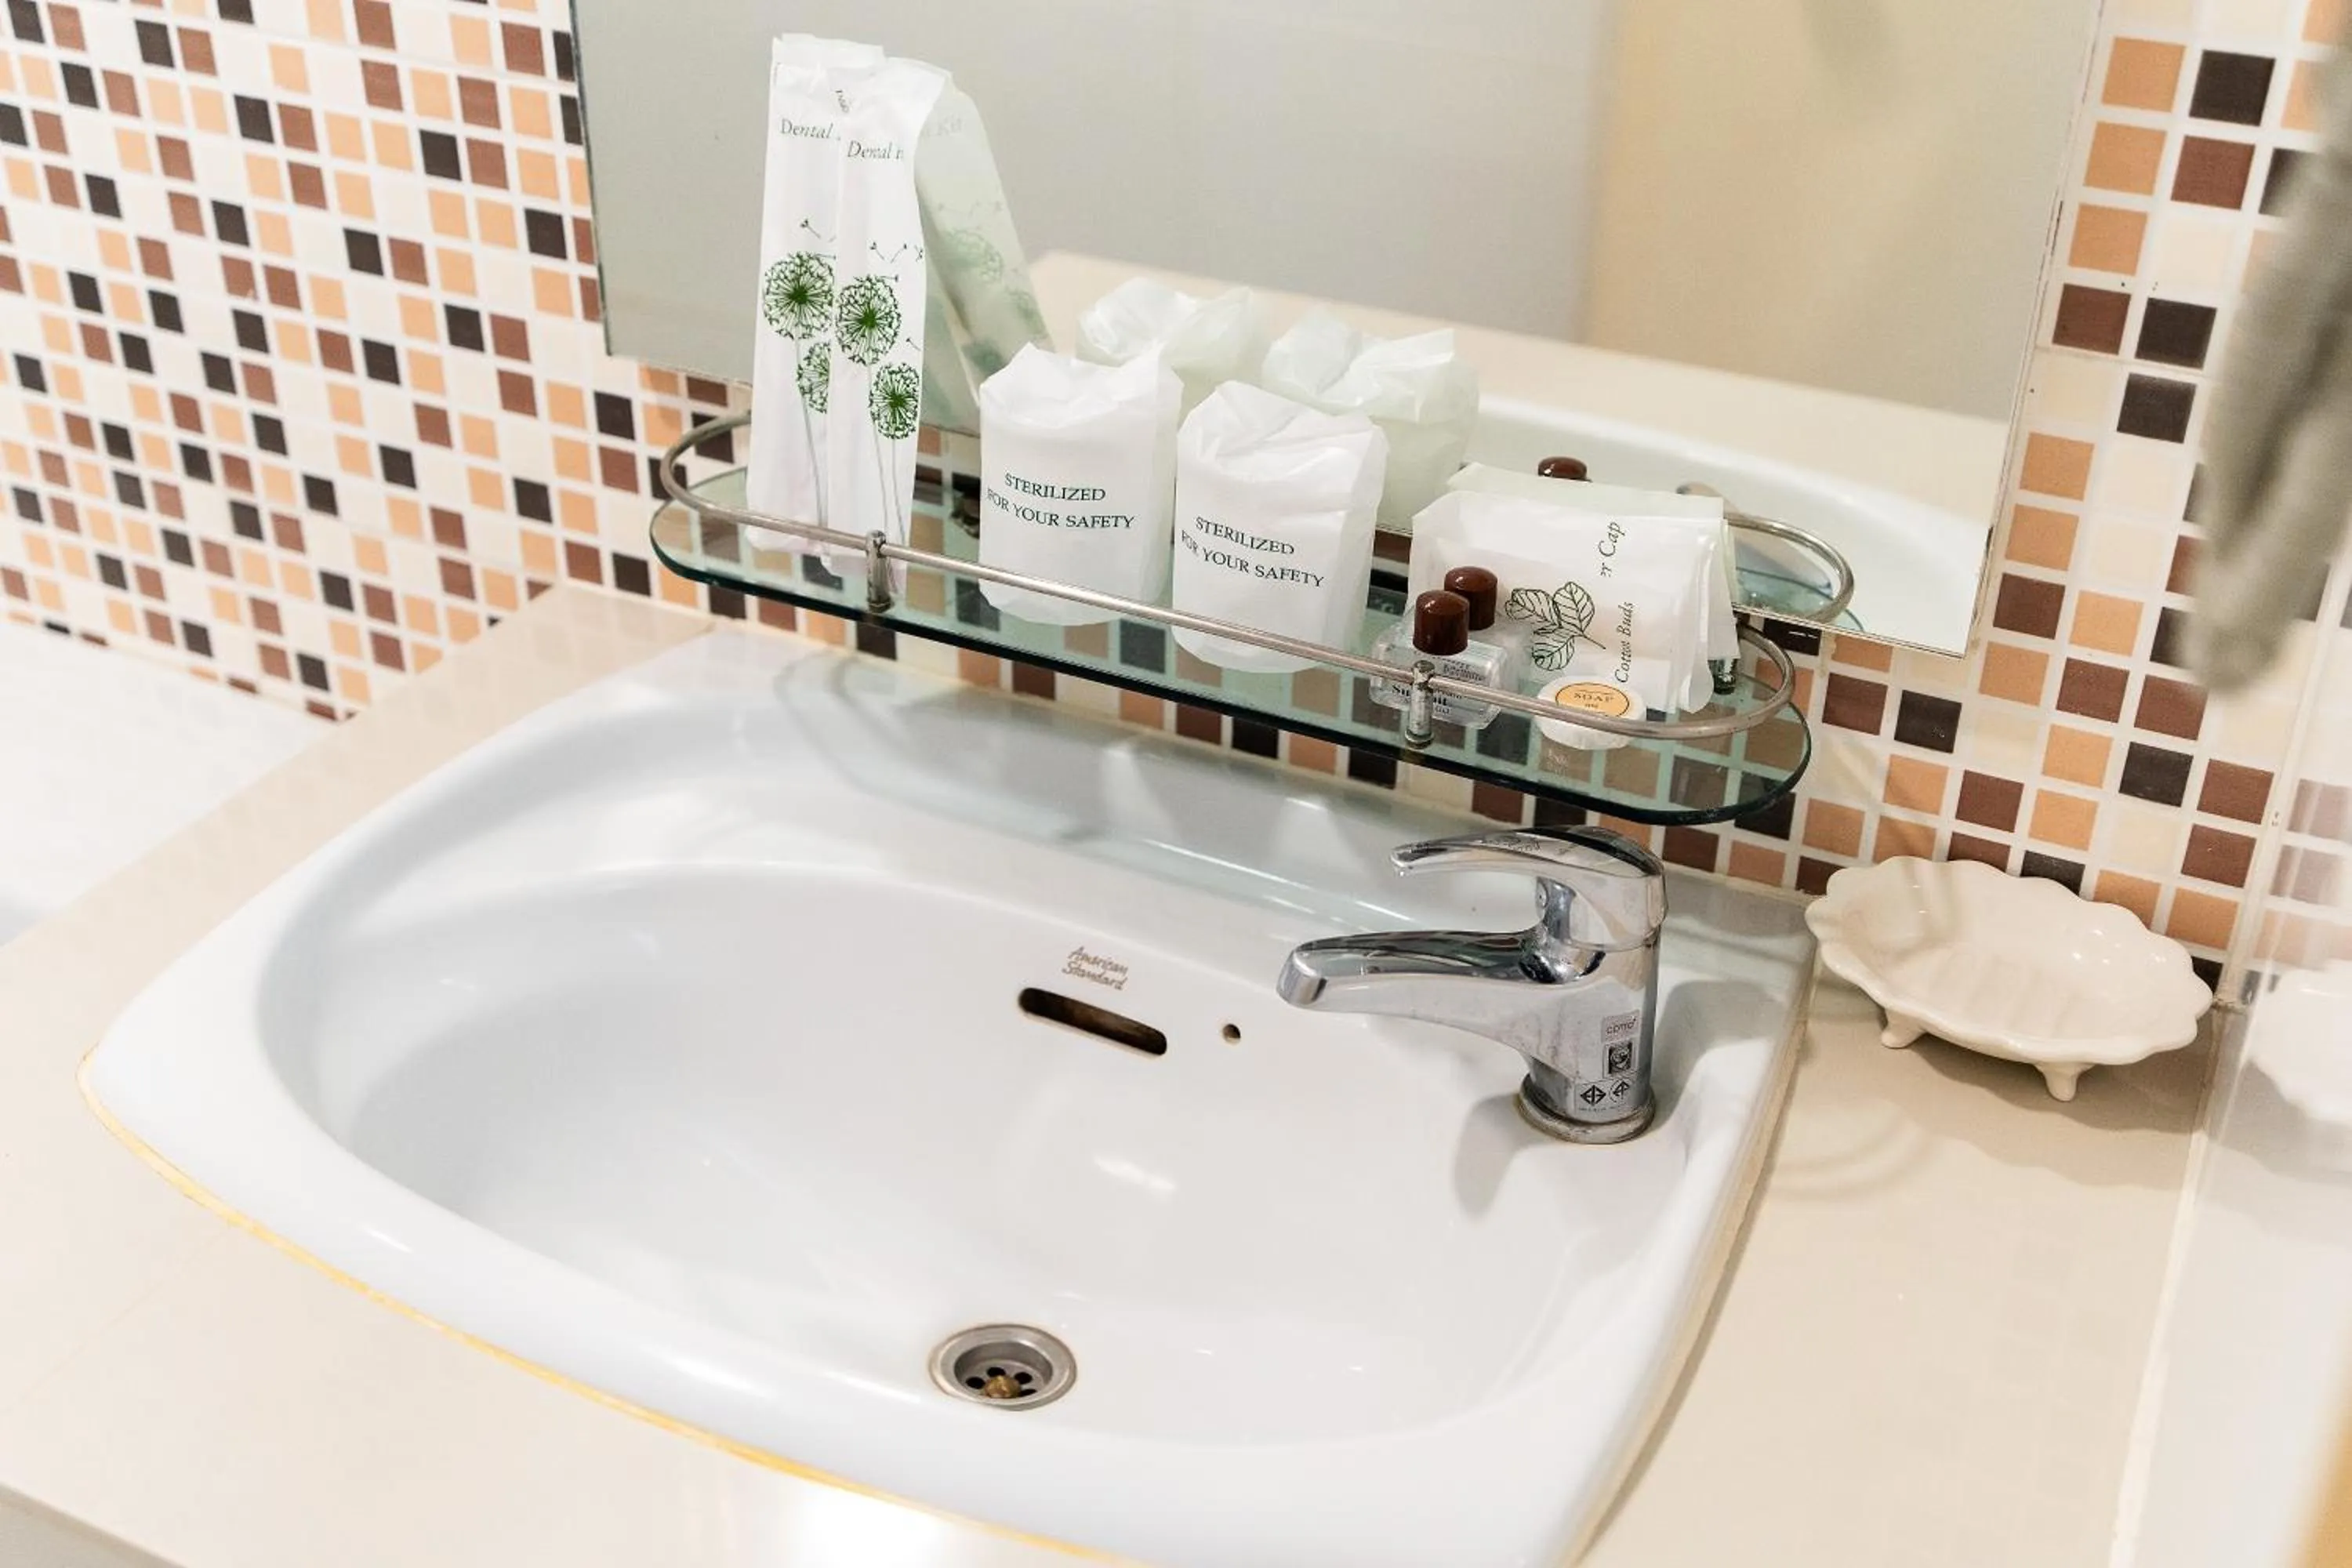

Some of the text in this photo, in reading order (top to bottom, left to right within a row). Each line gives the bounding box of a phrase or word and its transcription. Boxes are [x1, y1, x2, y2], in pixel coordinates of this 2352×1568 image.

[780, 118, 834, 140] Dental
[1004, 473, 1106, 501] STERILIZED
[986, 488, 1134, 529] FOR YOUR SAFETY
[1195, 516, 1295, 554] STERILIZED
[1598, 521, 1626, 557] Cap
[1203, 548, 1250, 574] YOUR
[1254, 564, 1325, 587] SAFETY
[1614, 601, 1634, 684] Cotton Buds
[1573, 692, 1615, 702] SOAP
[1062, 960, 1128, 991] Standard
[1068, 946, 1129, 975] American
